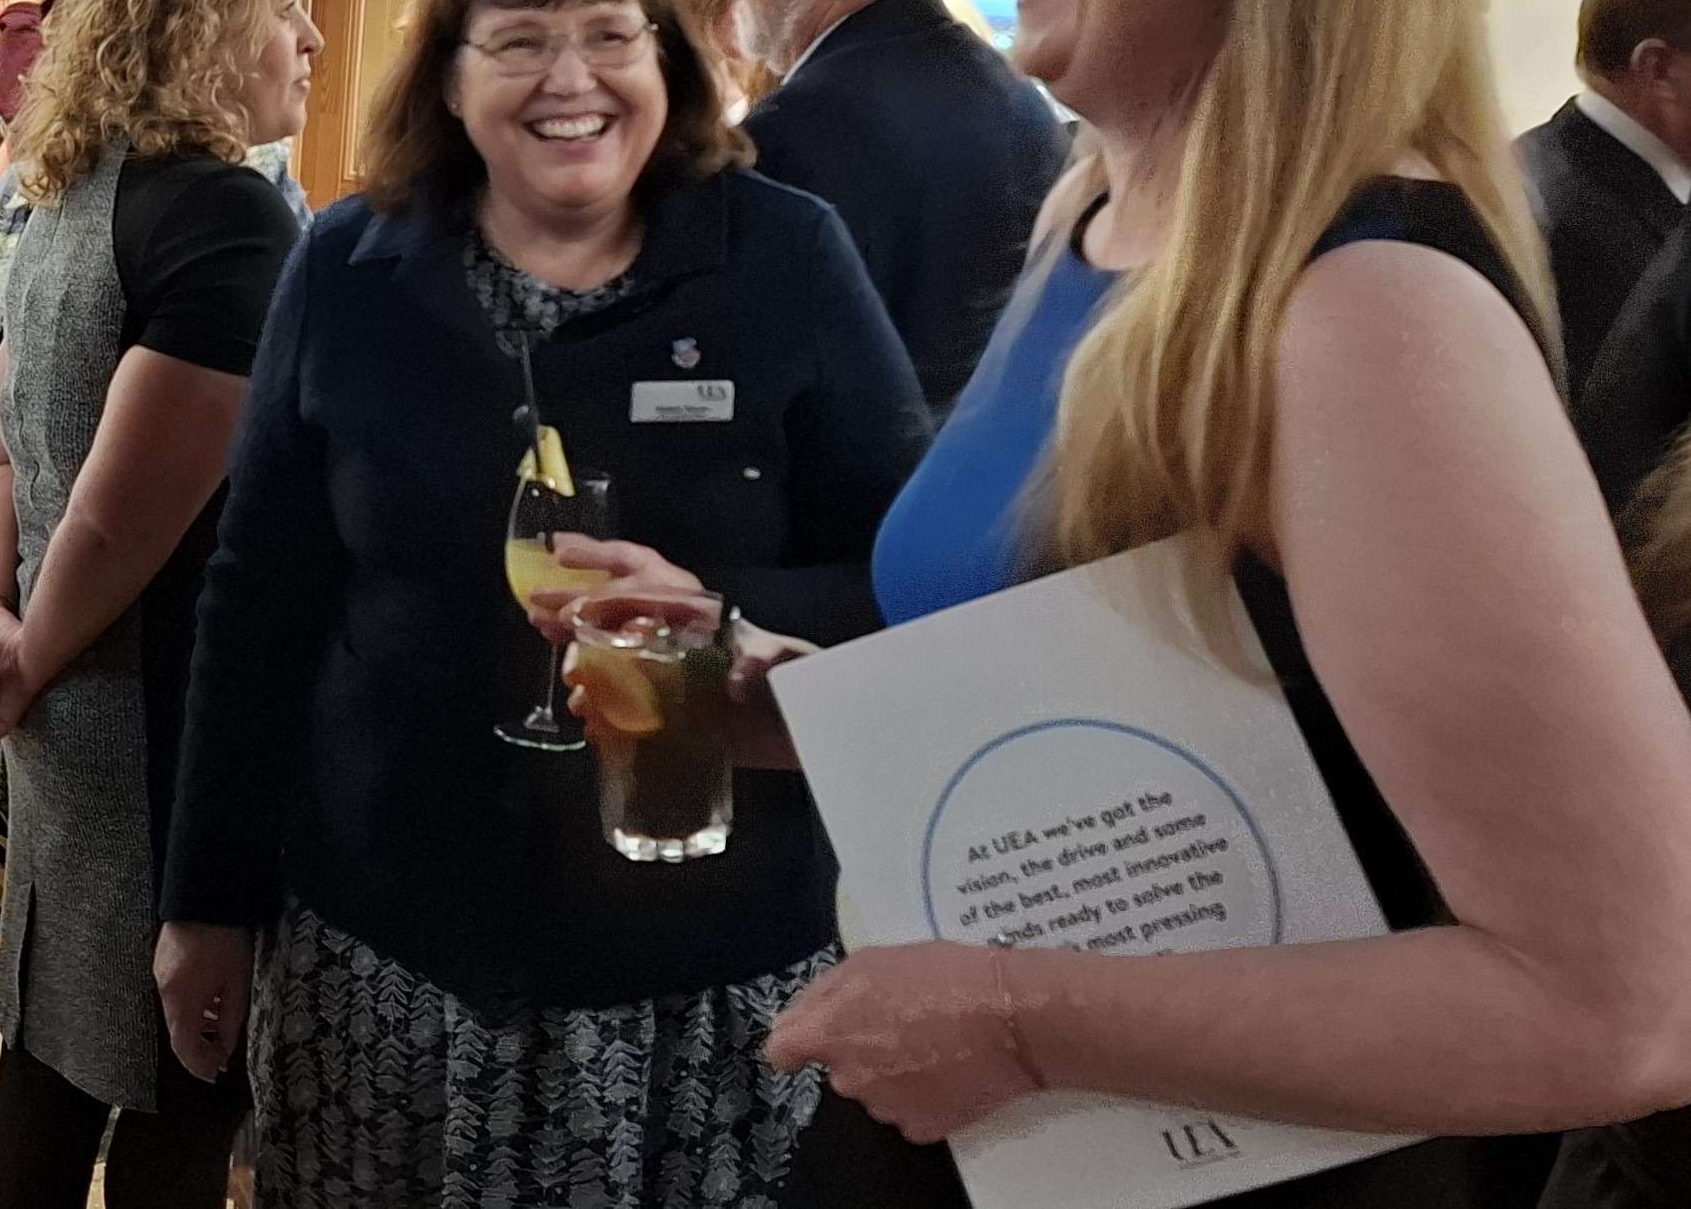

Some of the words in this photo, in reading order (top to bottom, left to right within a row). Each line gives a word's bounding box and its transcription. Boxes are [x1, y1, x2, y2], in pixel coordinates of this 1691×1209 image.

[956, 871, 1019, 894] vision,
[1019, 858, 1054, 877] the
[1056, 842, 1109, 866] drive
[1112, 825, 1150, 851] and
[1153, 813, 1207, 839] some
[968, 844, 990, 864] At
[991, 829, 1039, 854] UEA
[1042, 815, 1096, 840] we've
[1100, 801, 1136, 828] got
[1137, 791, 1173, 812] the
[959, 905, 978, 927] of
[982, 900, 1015, 919] the
[1072, 866, 1121, 894] most
[1123, 838, 1229, 879] innovative
[1048, 903, 1102, 933] ready
[1105, 898, 1130, 915] to
[1132, 882, 1185, 908] solve
[1187, 871, 1224, 892] the
[1086, 925, 1137, 952] most
[1139, 902, 1227, 943] pressing
